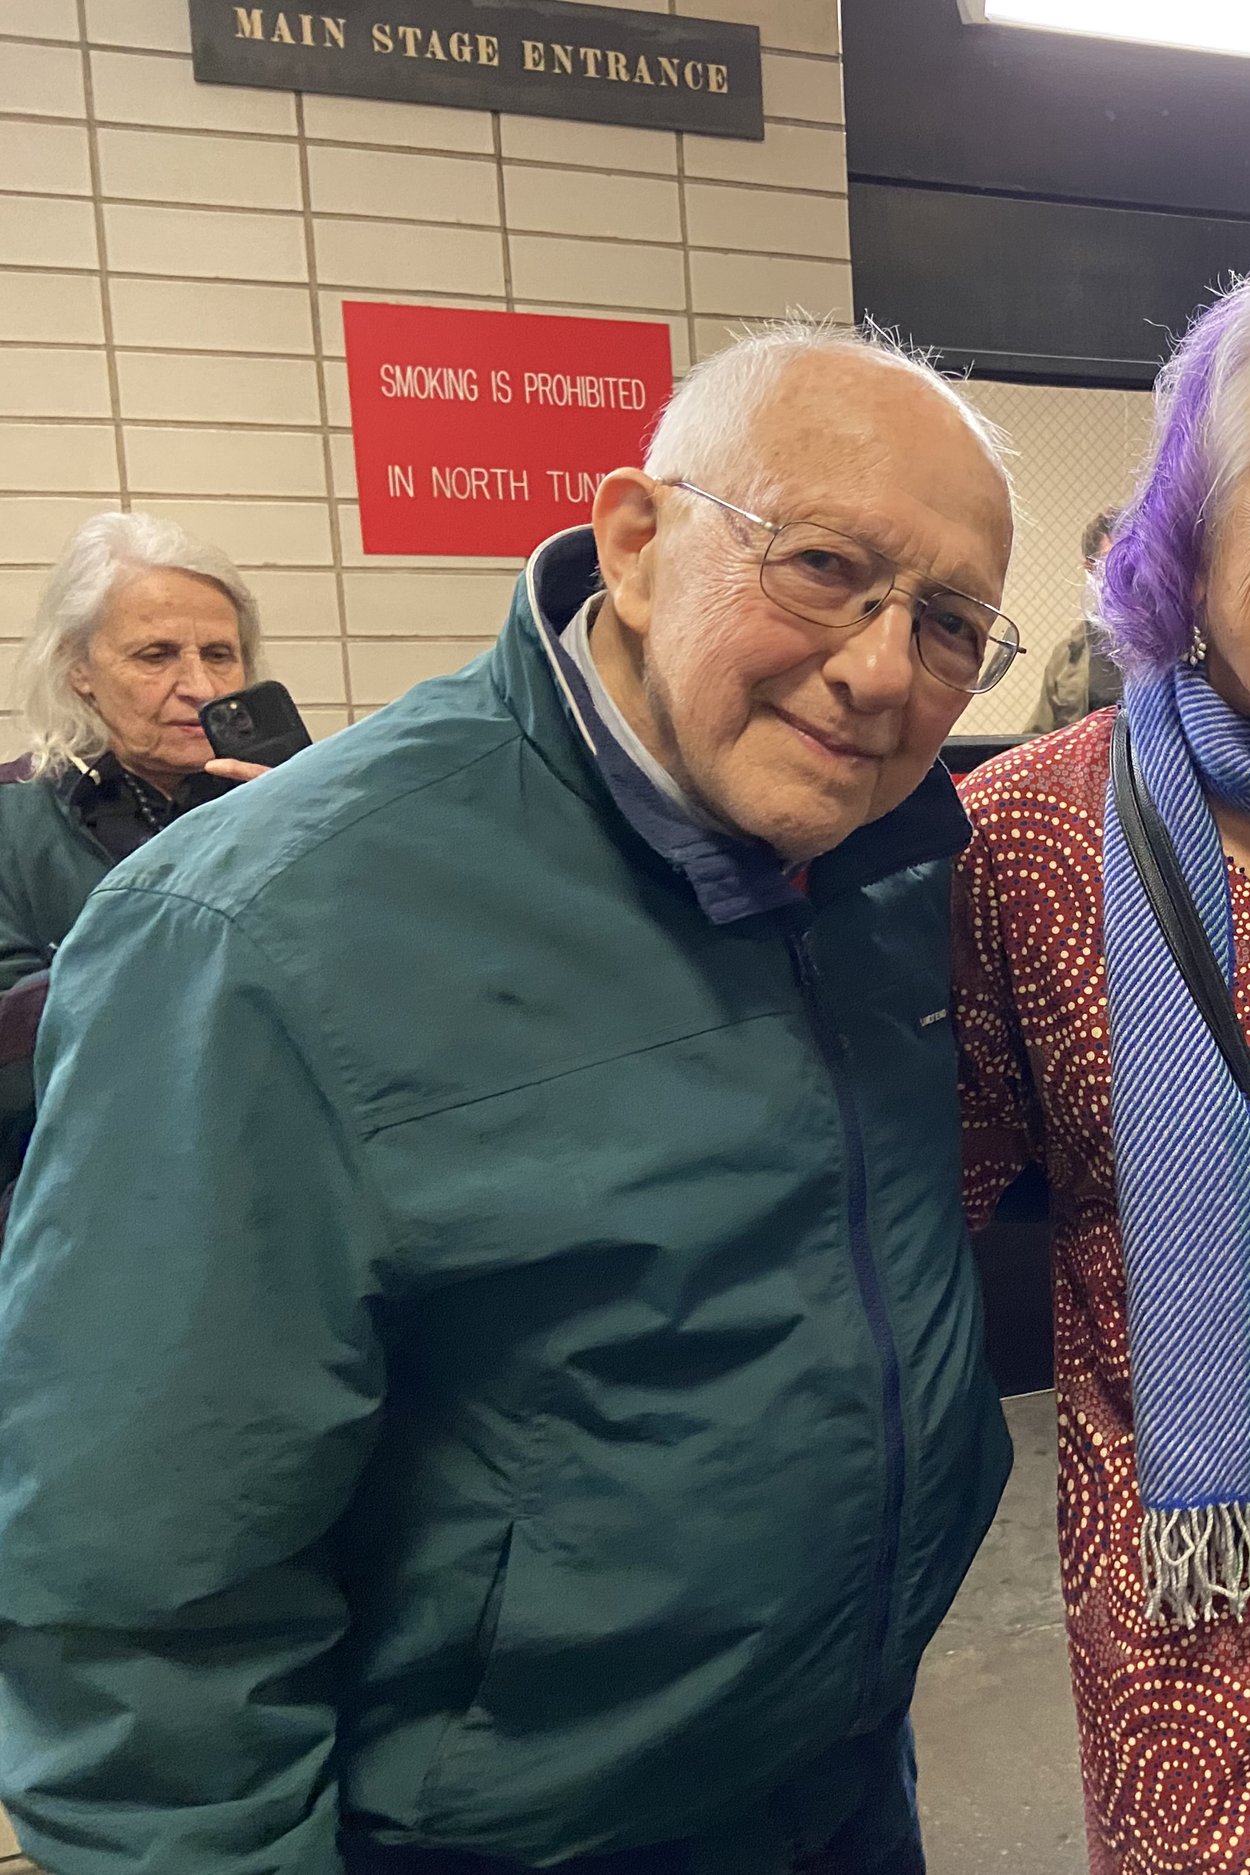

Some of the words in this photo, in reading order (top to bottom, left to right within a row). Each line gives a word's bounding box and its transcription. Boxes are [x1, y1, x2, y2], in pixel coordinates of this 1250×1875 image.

[234, 7, 347, 49] MAIN
[371, 23, 500, 66] STAGE
[522, 39, 729, 94] ENTRANCE
[380, 364, 479, 402] SMOKING
[490, 370, 512, 404] IS
[524, 372, 646, 410] PROHIBITED
[387, 464, 415, 499] IN
[431, 465, 529, 501] NORTH
[546, 470, 605, 503] TUN
